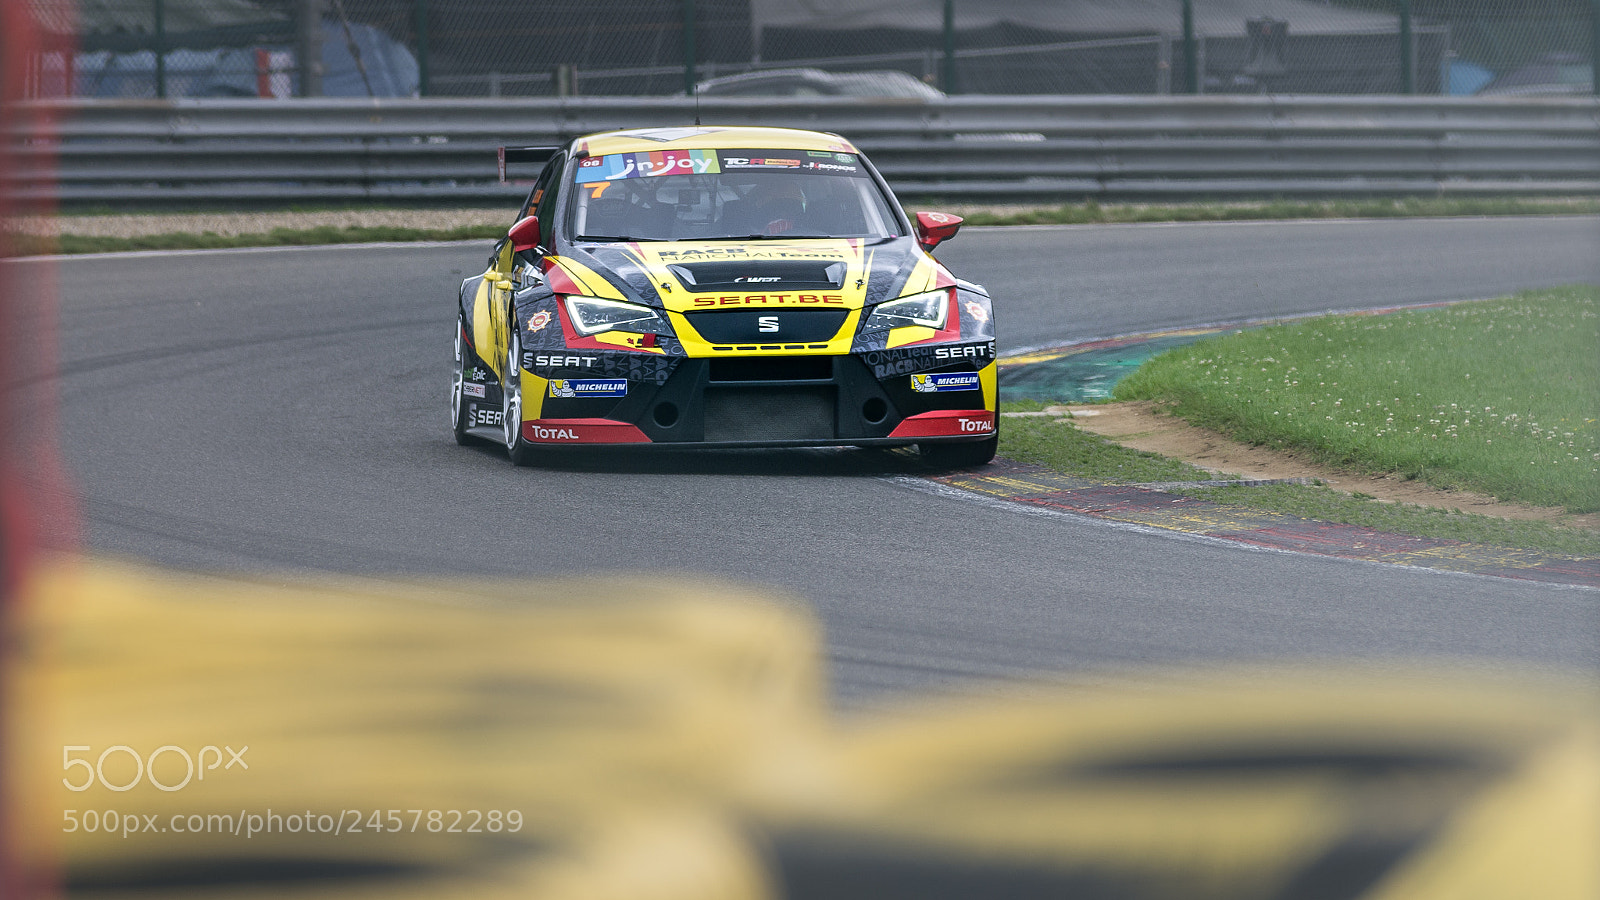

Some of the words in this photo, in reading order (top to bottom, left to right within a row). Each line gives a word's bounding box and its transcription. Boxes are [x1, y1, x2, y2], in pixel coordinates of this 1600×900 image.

[583, 181, 612, 199] 7
[694, 294, 844, 307] SEAT.BE
[935, 345, 987, 360] SEAT
[535, 355, 598, 367] SEAT
[937, 376, 978, 385] MICHELIN
[575, 383, 627, 391] MICHELIN
